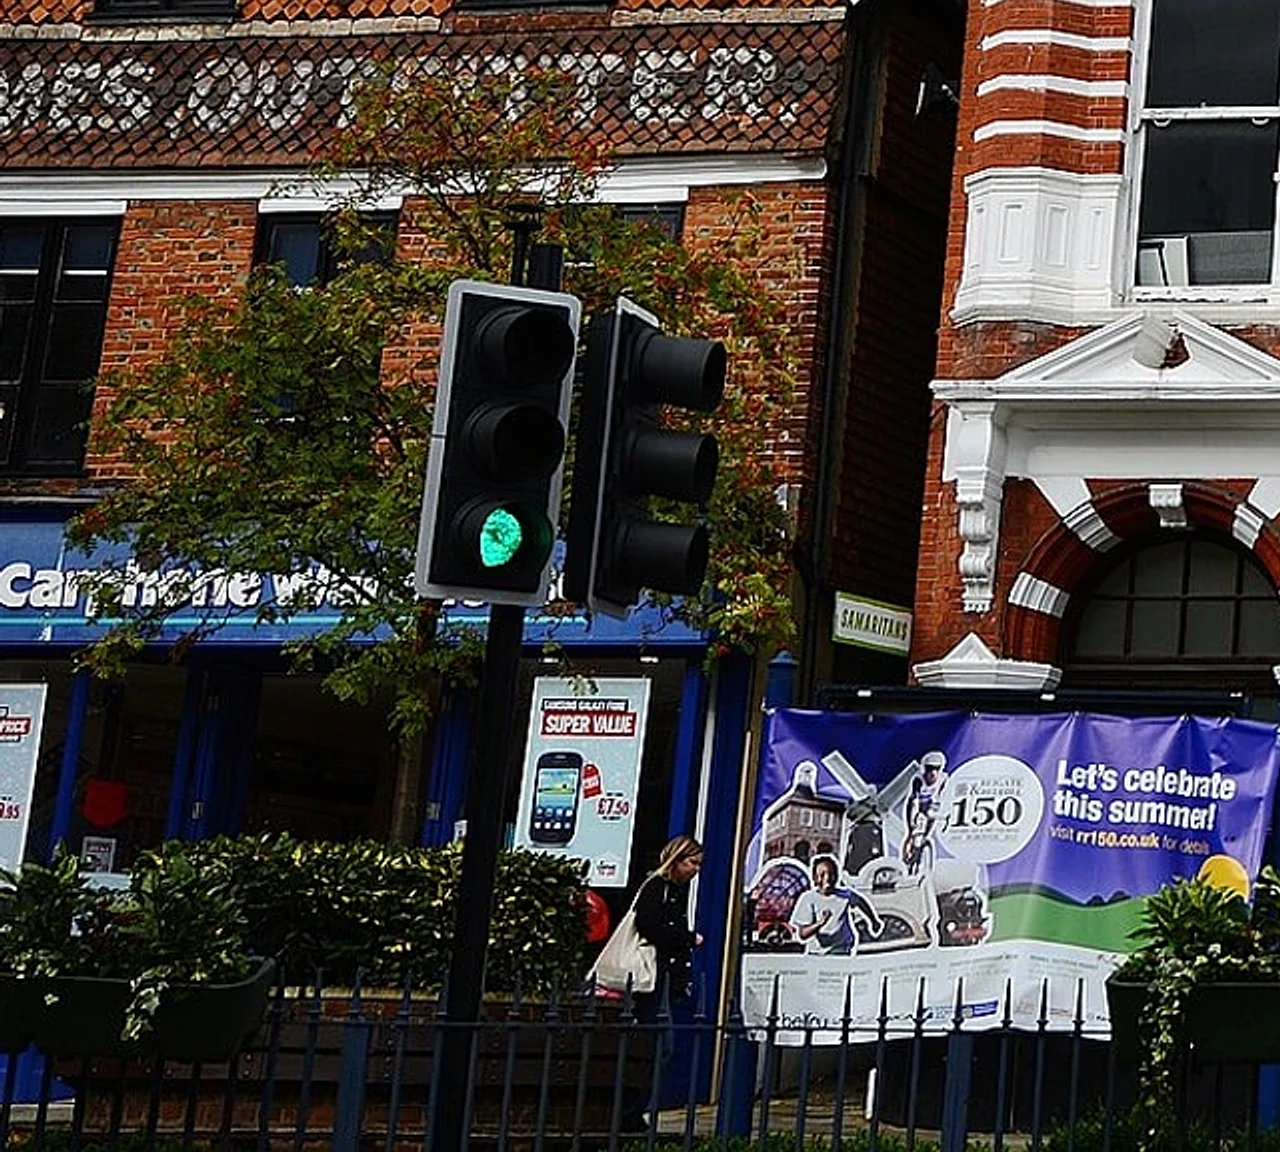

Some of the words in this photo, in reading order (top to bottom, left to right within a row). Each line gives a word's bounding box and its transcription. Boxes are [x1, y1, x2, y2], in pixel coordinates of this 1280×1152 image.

[841, 608, 908, 641] SAMARITANS
[545, 713, 591, 734] SUPER
[592, 714, 634, 734] VALUE
[1056, 759, 1118, 792] Let's
[1123, 765, 1237, 801] celebrate
[950, 795, 1023, 828] 150
[1053, 789, 1104, 823] this
[1108, 798, 1217, 832] summer!
